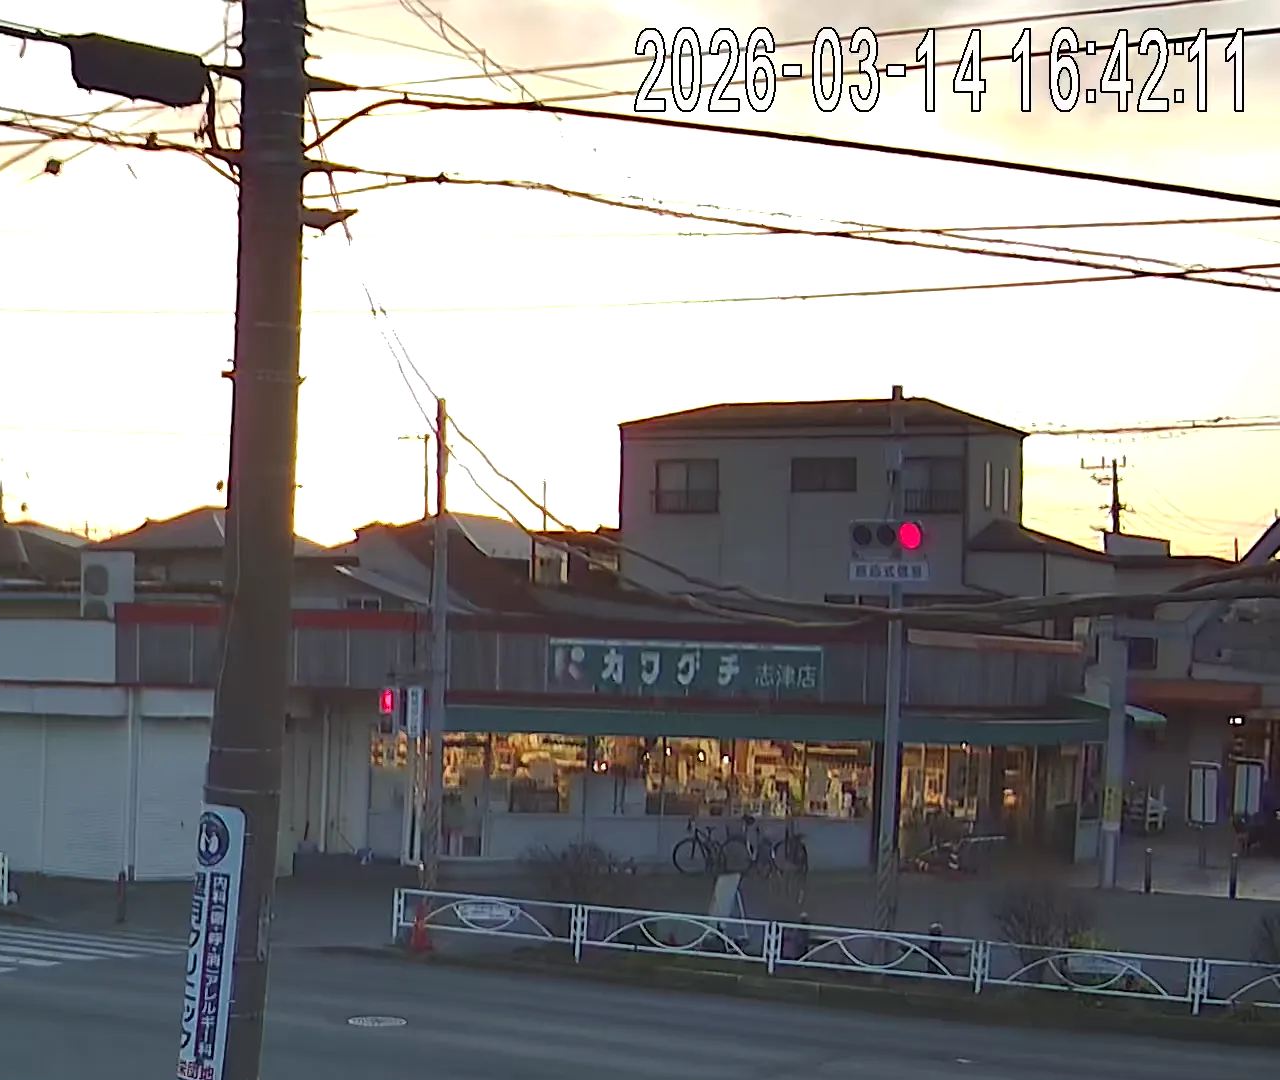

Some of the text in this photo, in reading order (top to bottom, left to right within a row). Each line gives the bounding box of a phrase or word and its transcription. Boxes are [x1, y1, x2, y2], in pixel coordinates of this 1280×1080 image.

[601, 647, 817, 689] カワグチ 志津店
